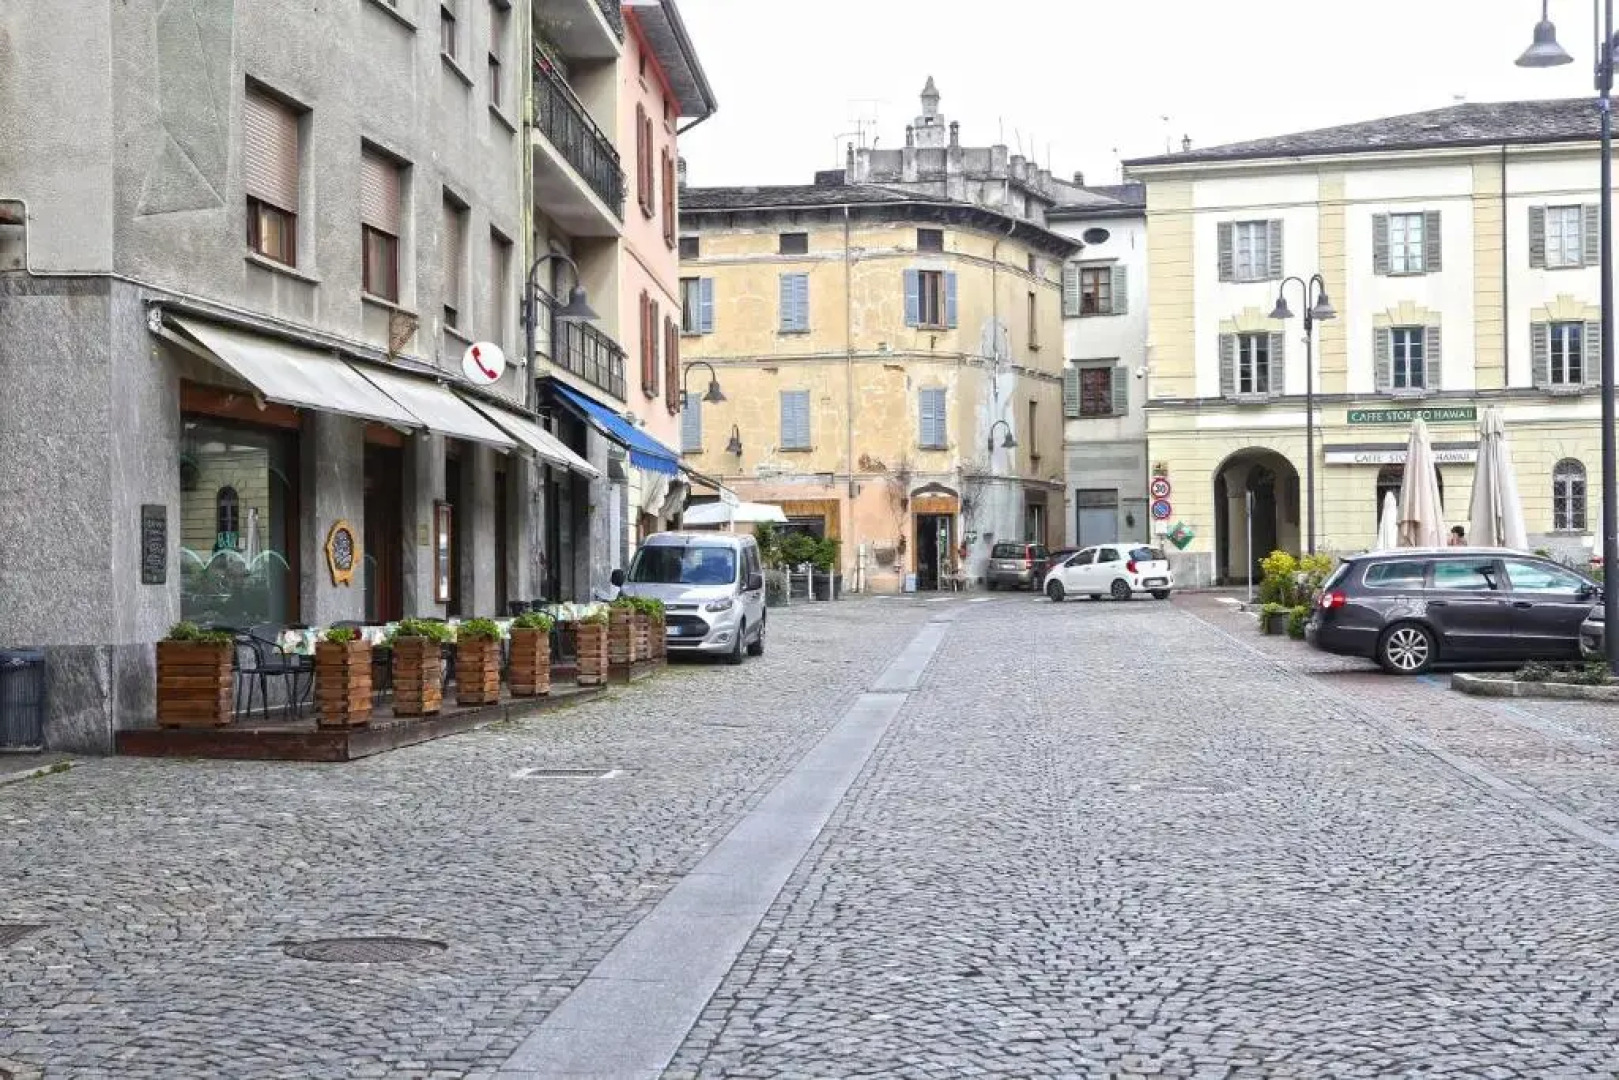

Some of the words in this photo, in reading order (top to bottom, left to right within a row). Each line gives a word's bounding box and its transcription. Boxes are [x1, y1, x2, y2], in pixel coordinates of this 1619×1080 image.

[1351, 412, 1383, 421] CAFFE
[1433, 409, 1473, 419] HAWAII
[1155, 483, 1166, 494] 30
